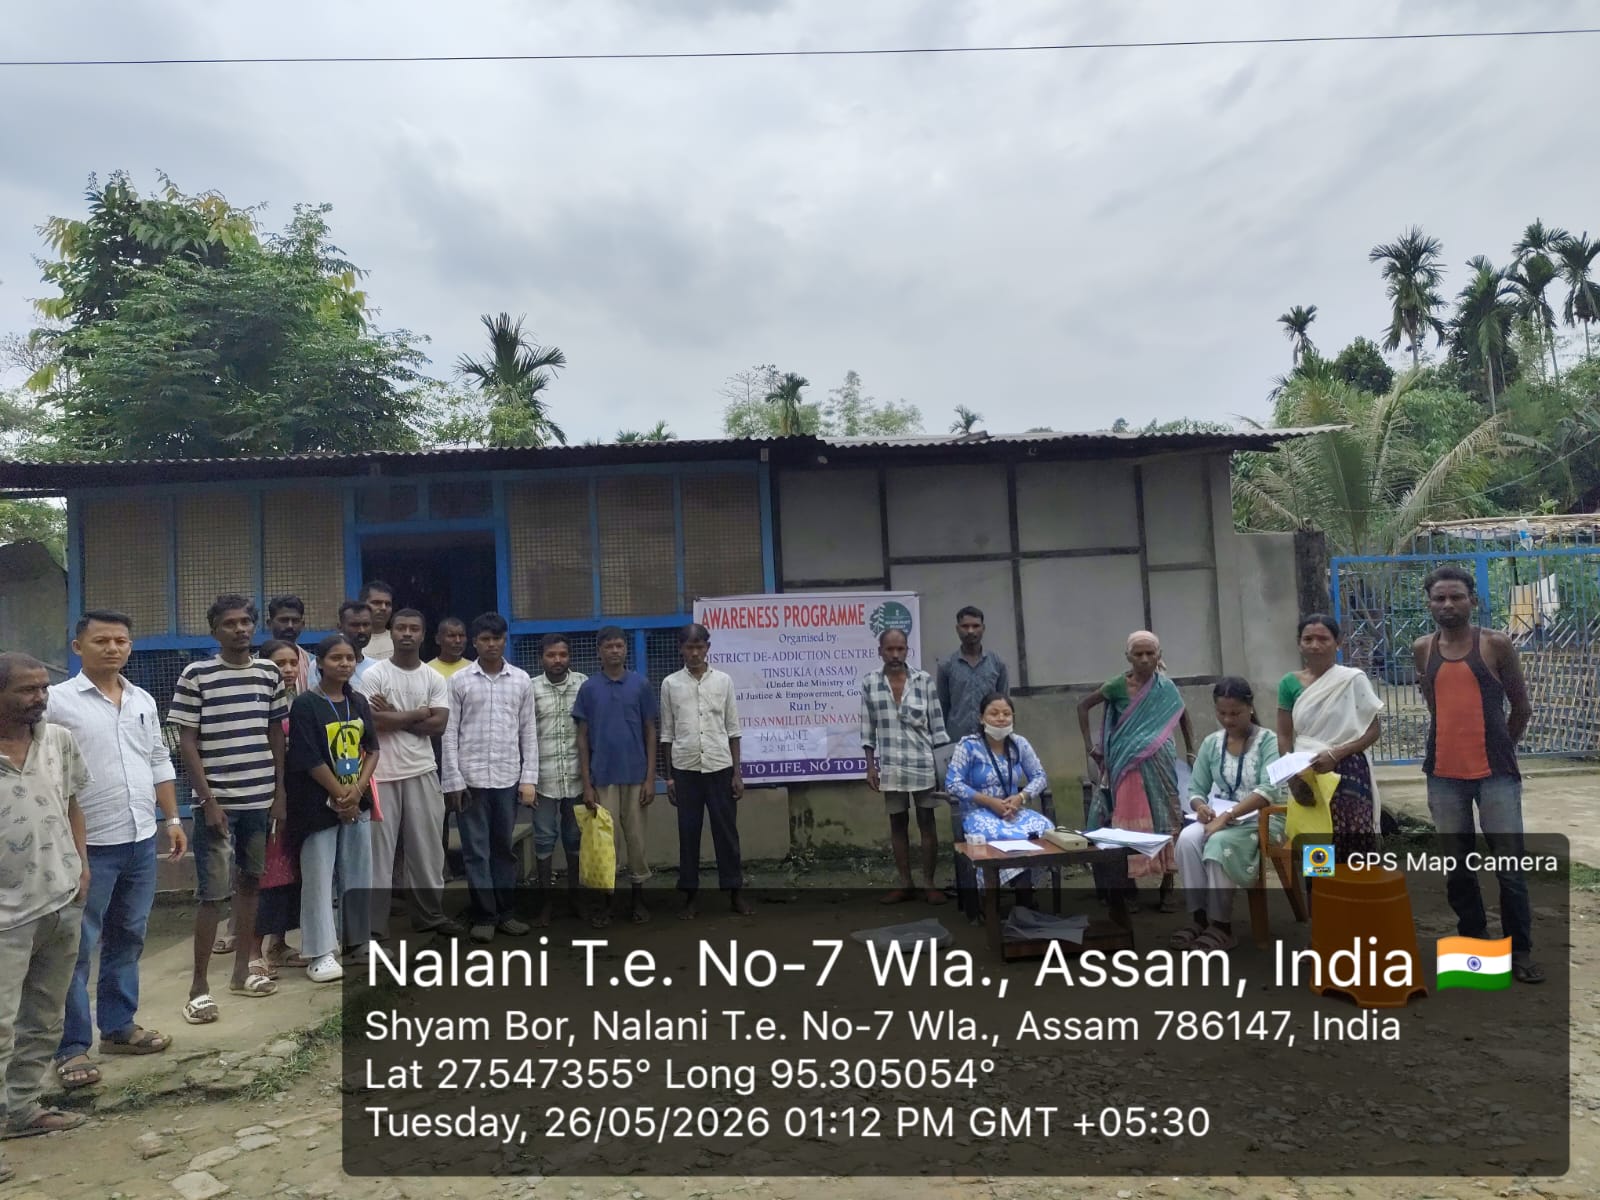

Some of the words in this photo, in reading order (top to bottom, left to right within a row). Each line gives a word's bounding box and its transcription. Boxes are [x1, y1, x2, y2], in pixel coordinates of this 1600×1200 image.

[702, 605, 779, 630] AWARENESS
[784, 603, 866, 628] PROGRAMME
[779, 632, 824, 645] Organised
[826, 632, 837, 644] by
[753, 649, 831, 662] DE-ADDICTION
[833, 648, 875, 659] CENTRE
[761, 667, 812, 678] TINSUKIA
[814, 665, 858, 677] (ASSAM)
[766, 680, 795, 689] (Under
[796, 680, 808, 688] the
[810, 679, 843, 688] Ministry
[846, 678, 856, 686] of
[746, 691, 773, 700] Justice
[775, 691, 783, 699] &
[785, 690, 844, 700] Empowerment,
[789, 701, 811, 711] Run
[814, 701, 827, 712] by
[753, 715, 811, 727] SANMILITA
[746, 763, 766, 775] TO
[770, 761, 806, 774] LIFE,
[809, 760, 831, 772] NO
[834, 760, 854, 771] TO
